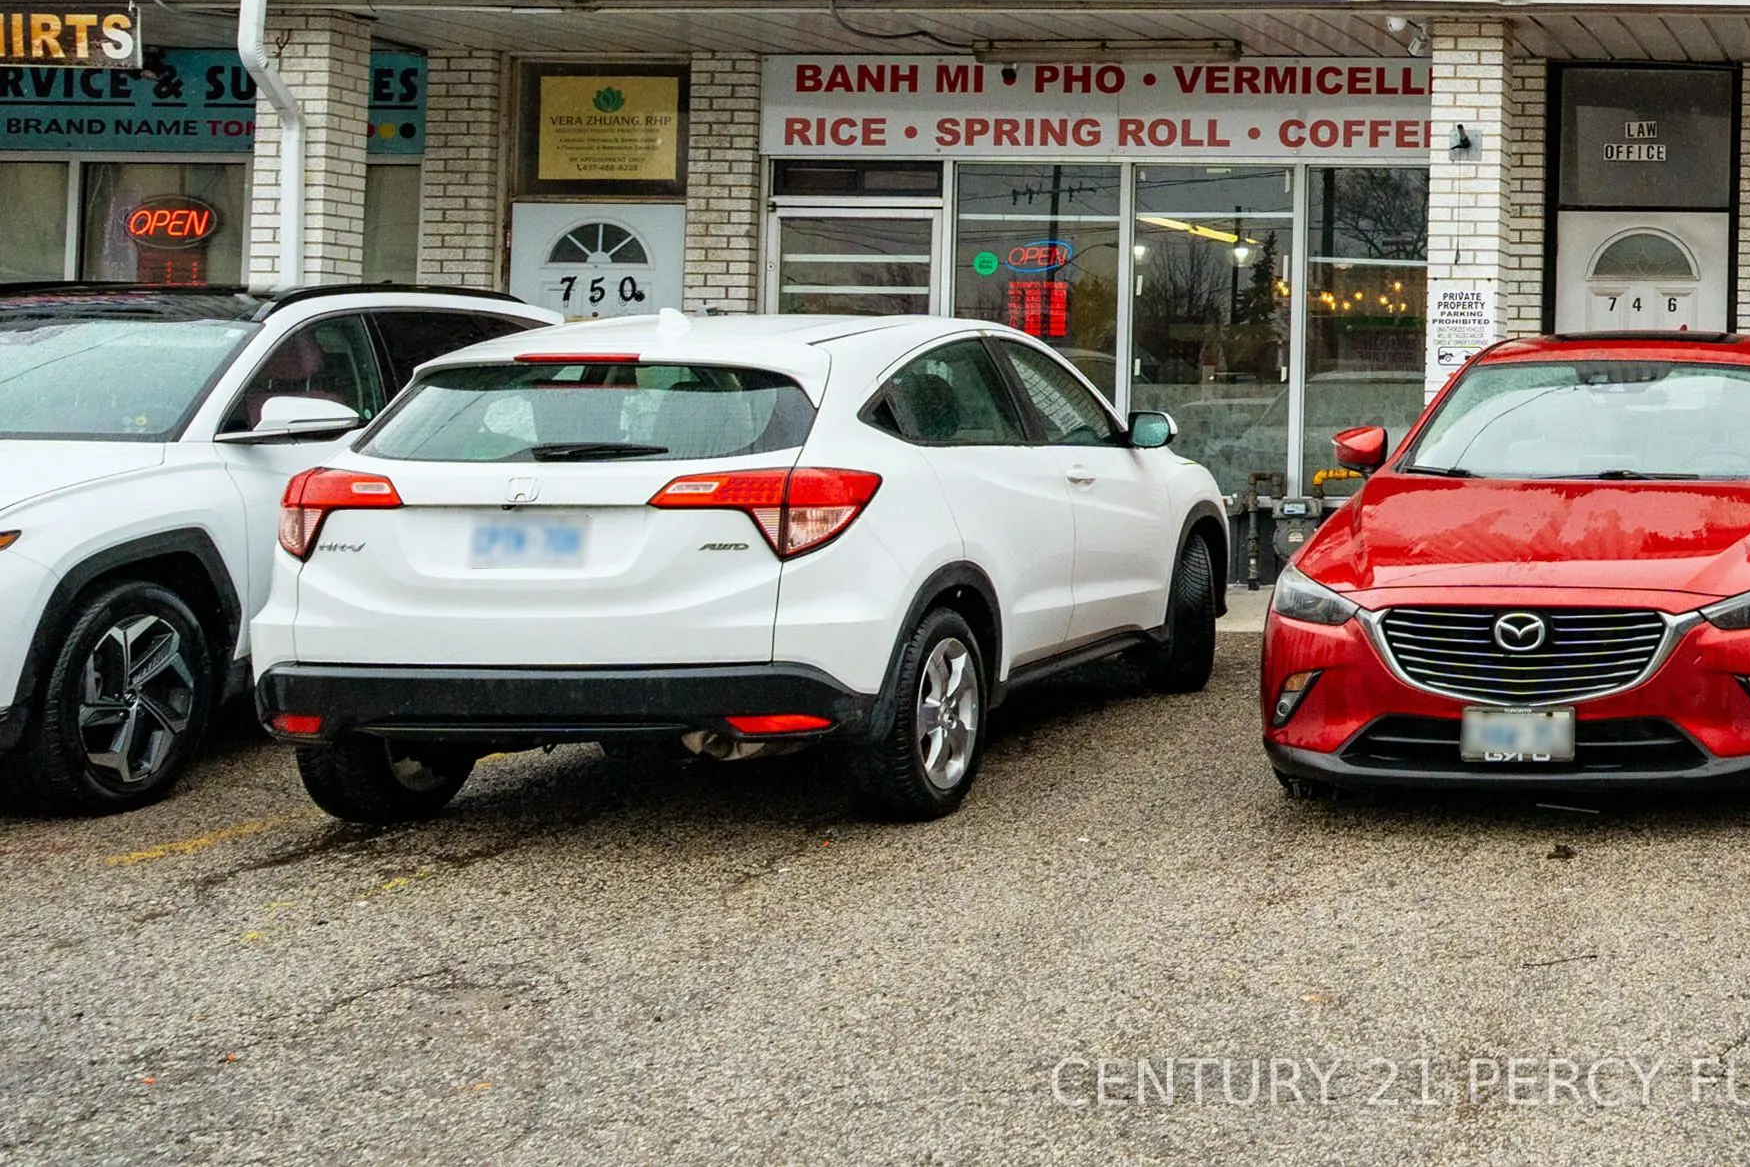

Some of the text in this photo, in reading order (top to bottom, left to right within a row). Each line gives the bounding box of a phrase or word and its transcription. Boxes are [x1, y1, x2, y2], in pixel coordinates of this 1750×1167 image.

[0, 13, 134, 59] IRTS
[795, 64, 919, 93] BANH
[936, 65, 984, 93] MI
[1034, 65, 1126, 94] PHO
[7, 118, 106, 135] BRAND
[115, 119, 199, 135] NAME
[550, 116, 582, 126] VERA
[645, 116, 672, 126] RHP
[784, 118, 887, 146] RICE
[935, 118, 1102, 147] SPRING
[1118, 119, 1230, 147] ROLL
[1627, 123, 1657, 137] LAW
[1605, 145, 1665, 159] OFFICE
[129, 209, 209, 236] OPEN
[1007, 246, 1068, 265] OPEN
[560, 276, 637, 302] 750
[1442, 292, 1482, 300] PRIVATE
[1437, 301, 1486, 310] PROPERTY
[1608, 297, 1677, 313] 746
[698, 542, 750, 551] AWD
